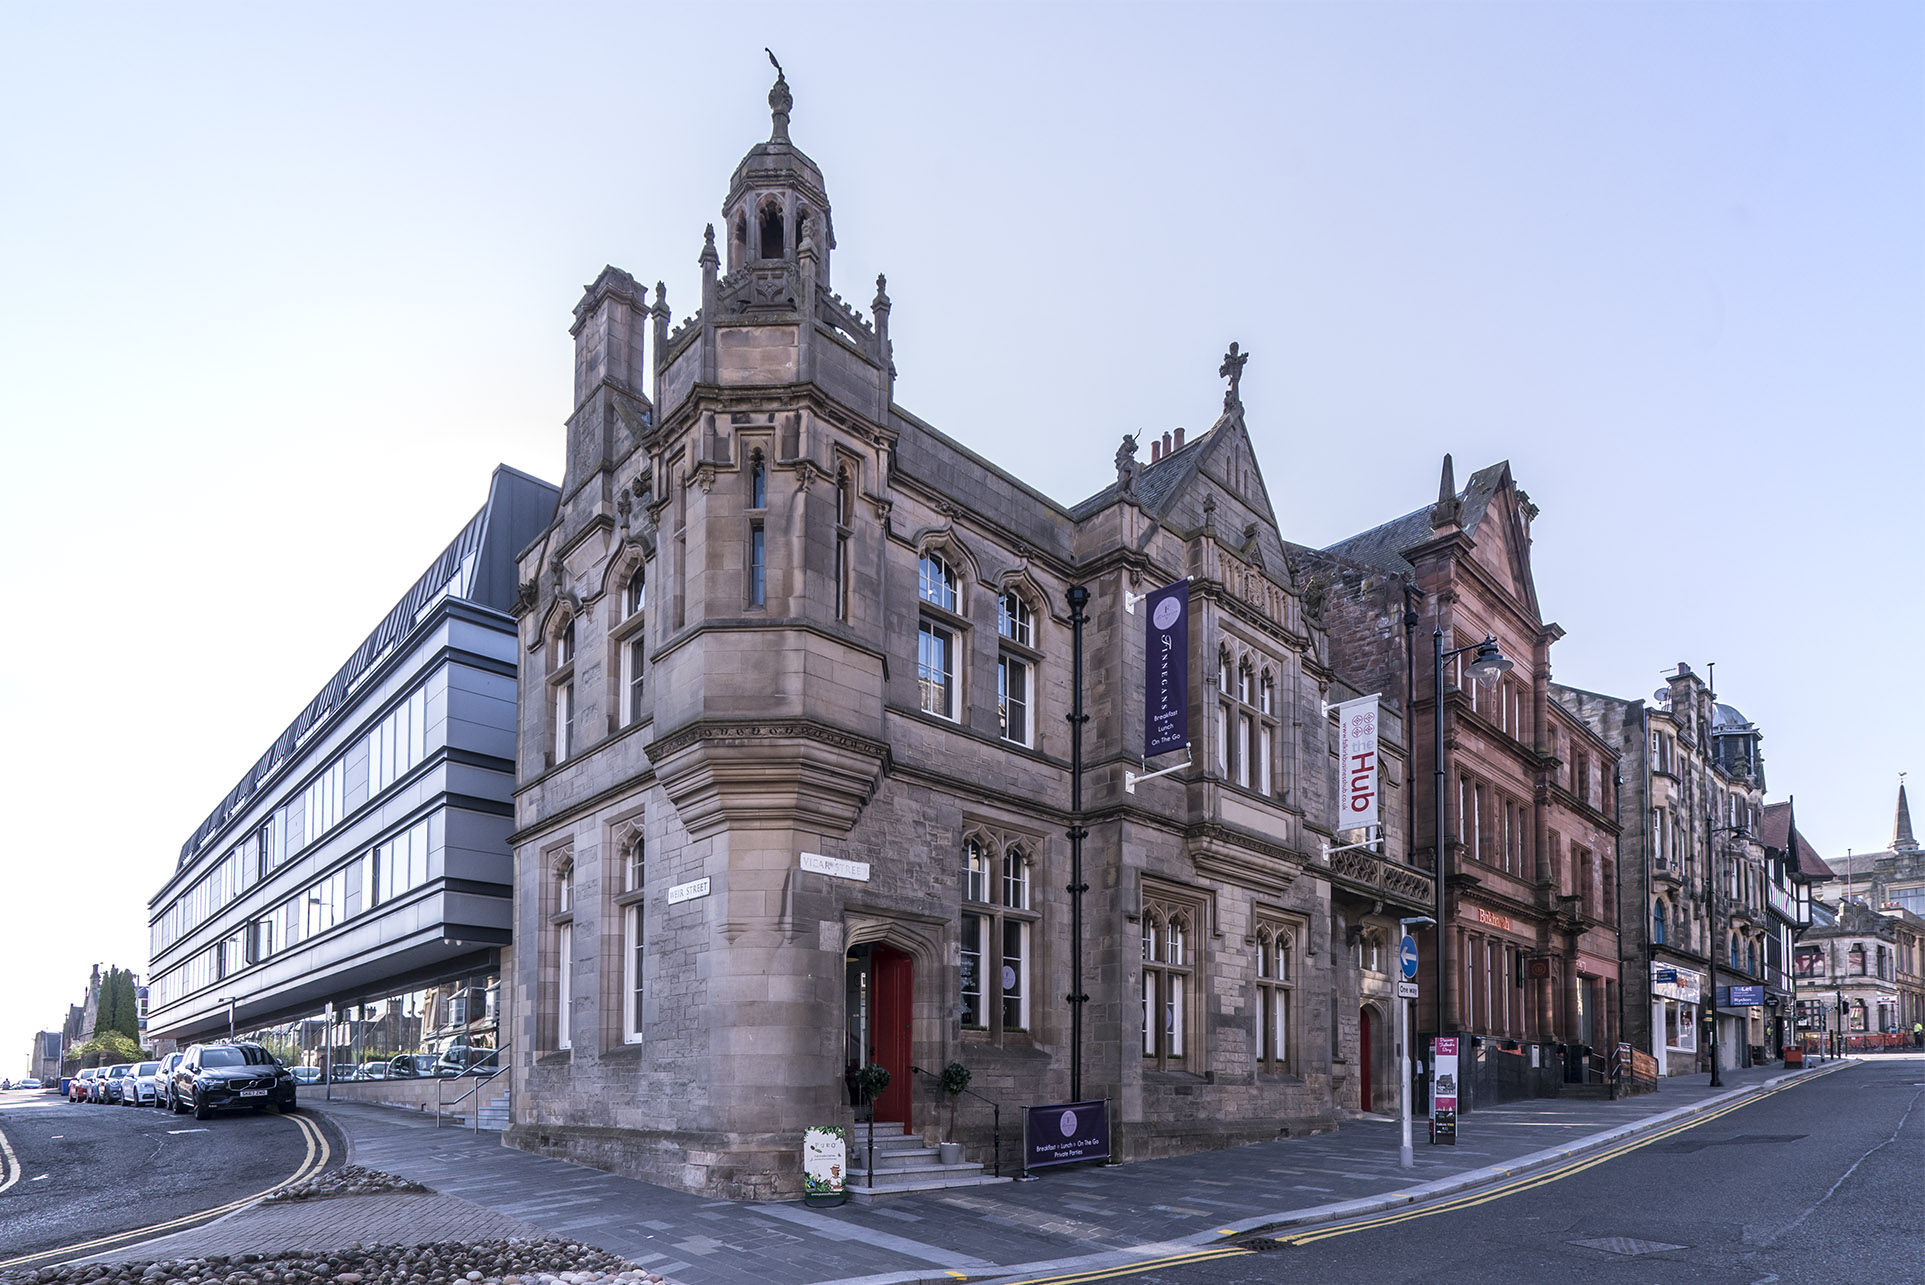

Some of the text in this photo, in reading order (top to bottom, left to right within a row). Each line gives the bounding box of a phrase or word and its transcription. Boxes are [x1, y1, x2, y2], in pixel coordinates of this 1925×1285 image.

[1161, 634, 1172, 710] FINNEGANS
[1153, 710, 1178, 722] Breakfast
[1158, 723, 1174, 732] Lunch
[1171, 733, 1181, 741] Go
[1352, 740, 1375, 752] the
[1351, 751, 1375, 812] Hub
[834, 862, 867, 876] STREE
[686, 881, 708, 896] STREET
[1400, 985, 1409, 993] One
